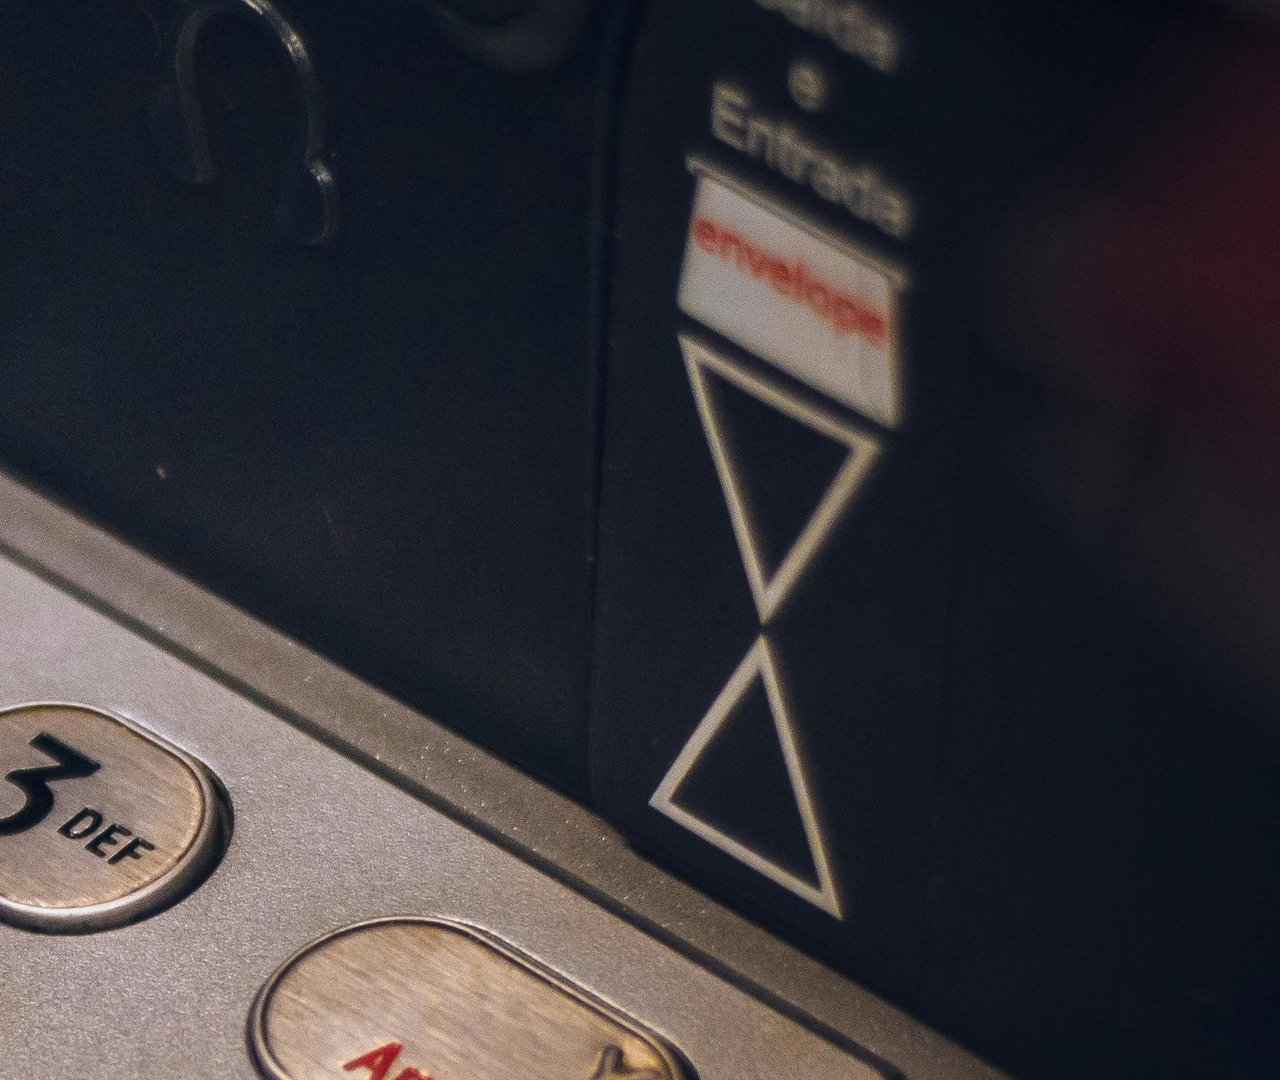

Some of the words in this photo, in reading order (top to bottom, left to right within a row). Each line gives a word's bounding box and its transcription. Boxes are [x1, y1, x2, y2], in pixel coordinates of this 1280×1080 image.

[710, 80, 912, 238] Entrada
[692, 217, 888, 346] envelope
[56, 806, 156, 867] DEF
